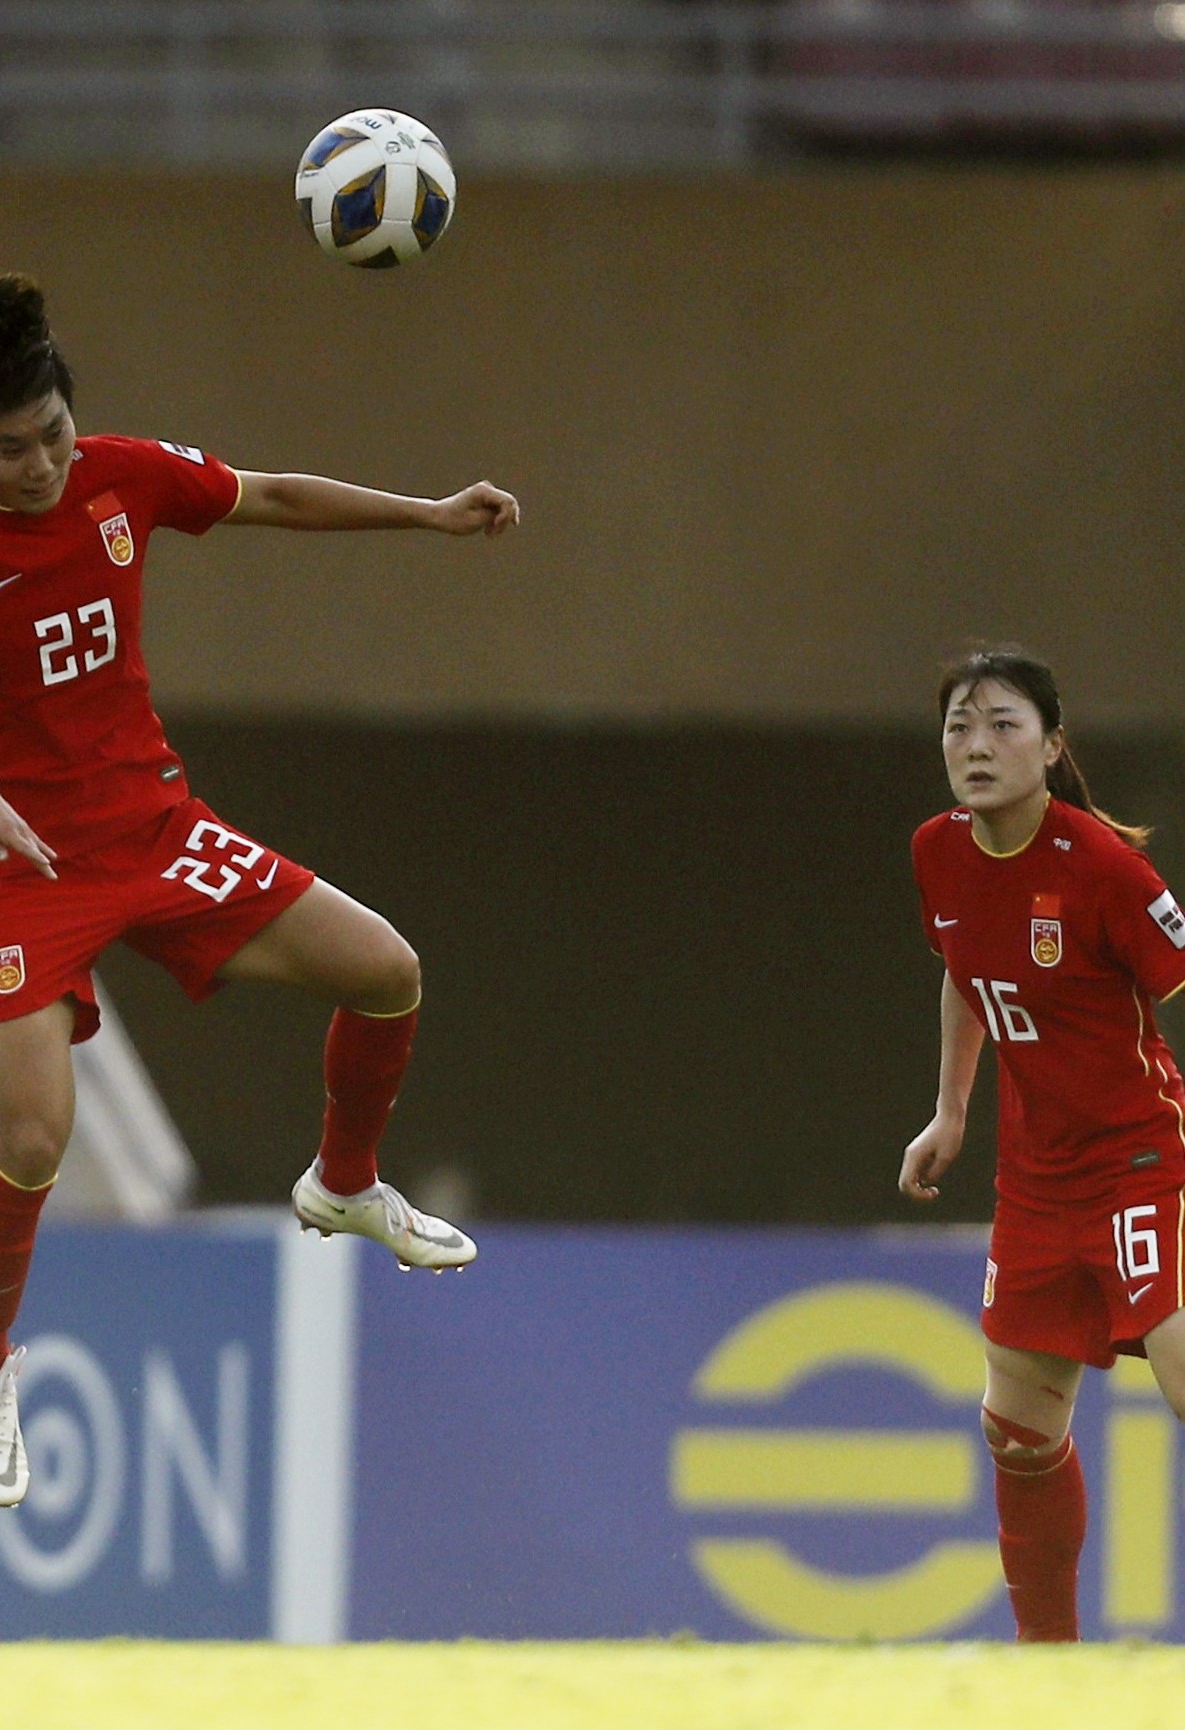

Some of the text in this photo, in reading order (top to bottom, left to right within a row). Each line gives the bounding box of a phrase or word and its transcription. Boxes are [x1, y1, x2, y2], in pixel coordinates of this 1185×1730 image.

[33, 597, 117, 686] 23
[160, 819, 265, 903] 23
[971, 977, 1039, 1042] 16
[1112, 1205, 1160, 1282] 16
